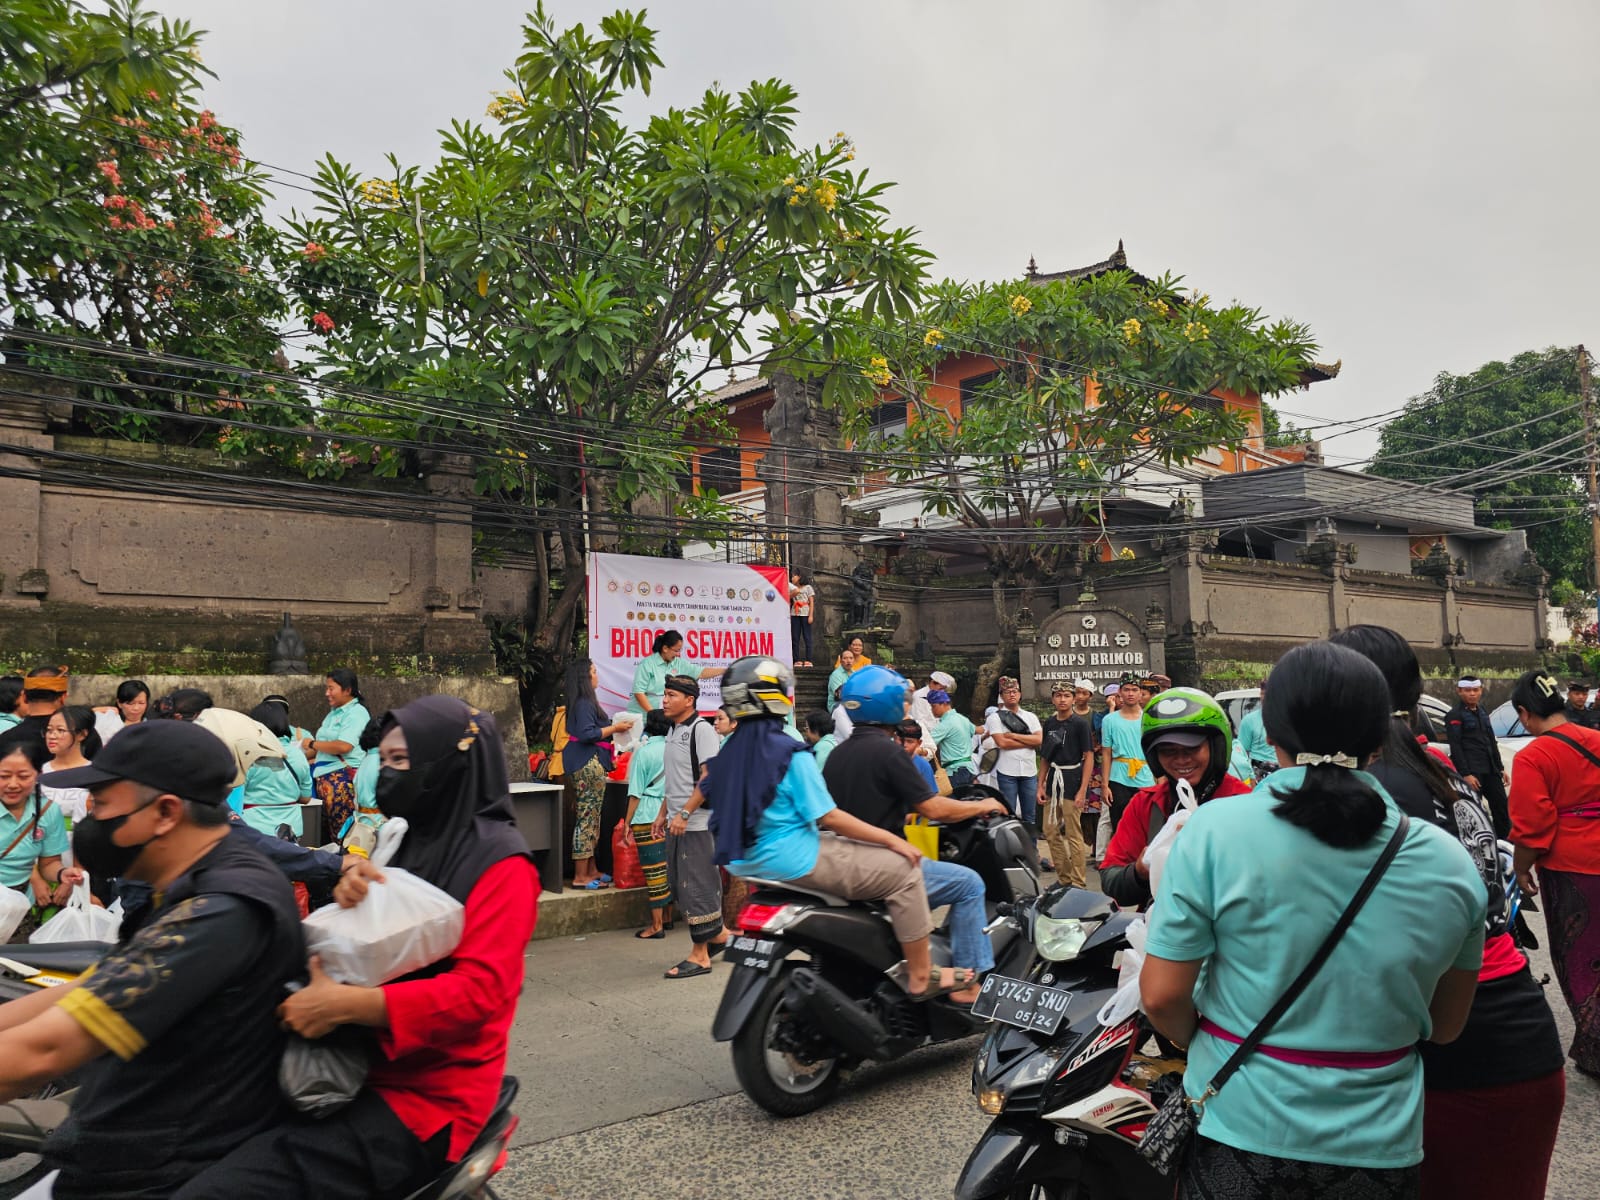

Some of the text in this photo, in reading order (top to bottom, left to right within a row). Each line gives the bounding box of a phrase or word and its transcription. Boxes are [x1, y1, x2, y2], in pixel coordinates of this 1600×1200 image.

[686, 630, 774, 658] SEVANAM
[1069, 633, 1110, 648] PURA
[1039, 652, 1144, 667] KORPS BRIMOB
[982, 977, 1068, 1012] B 3745 SNU
[1092, 1103, 1115, 1118] YAMAHA
